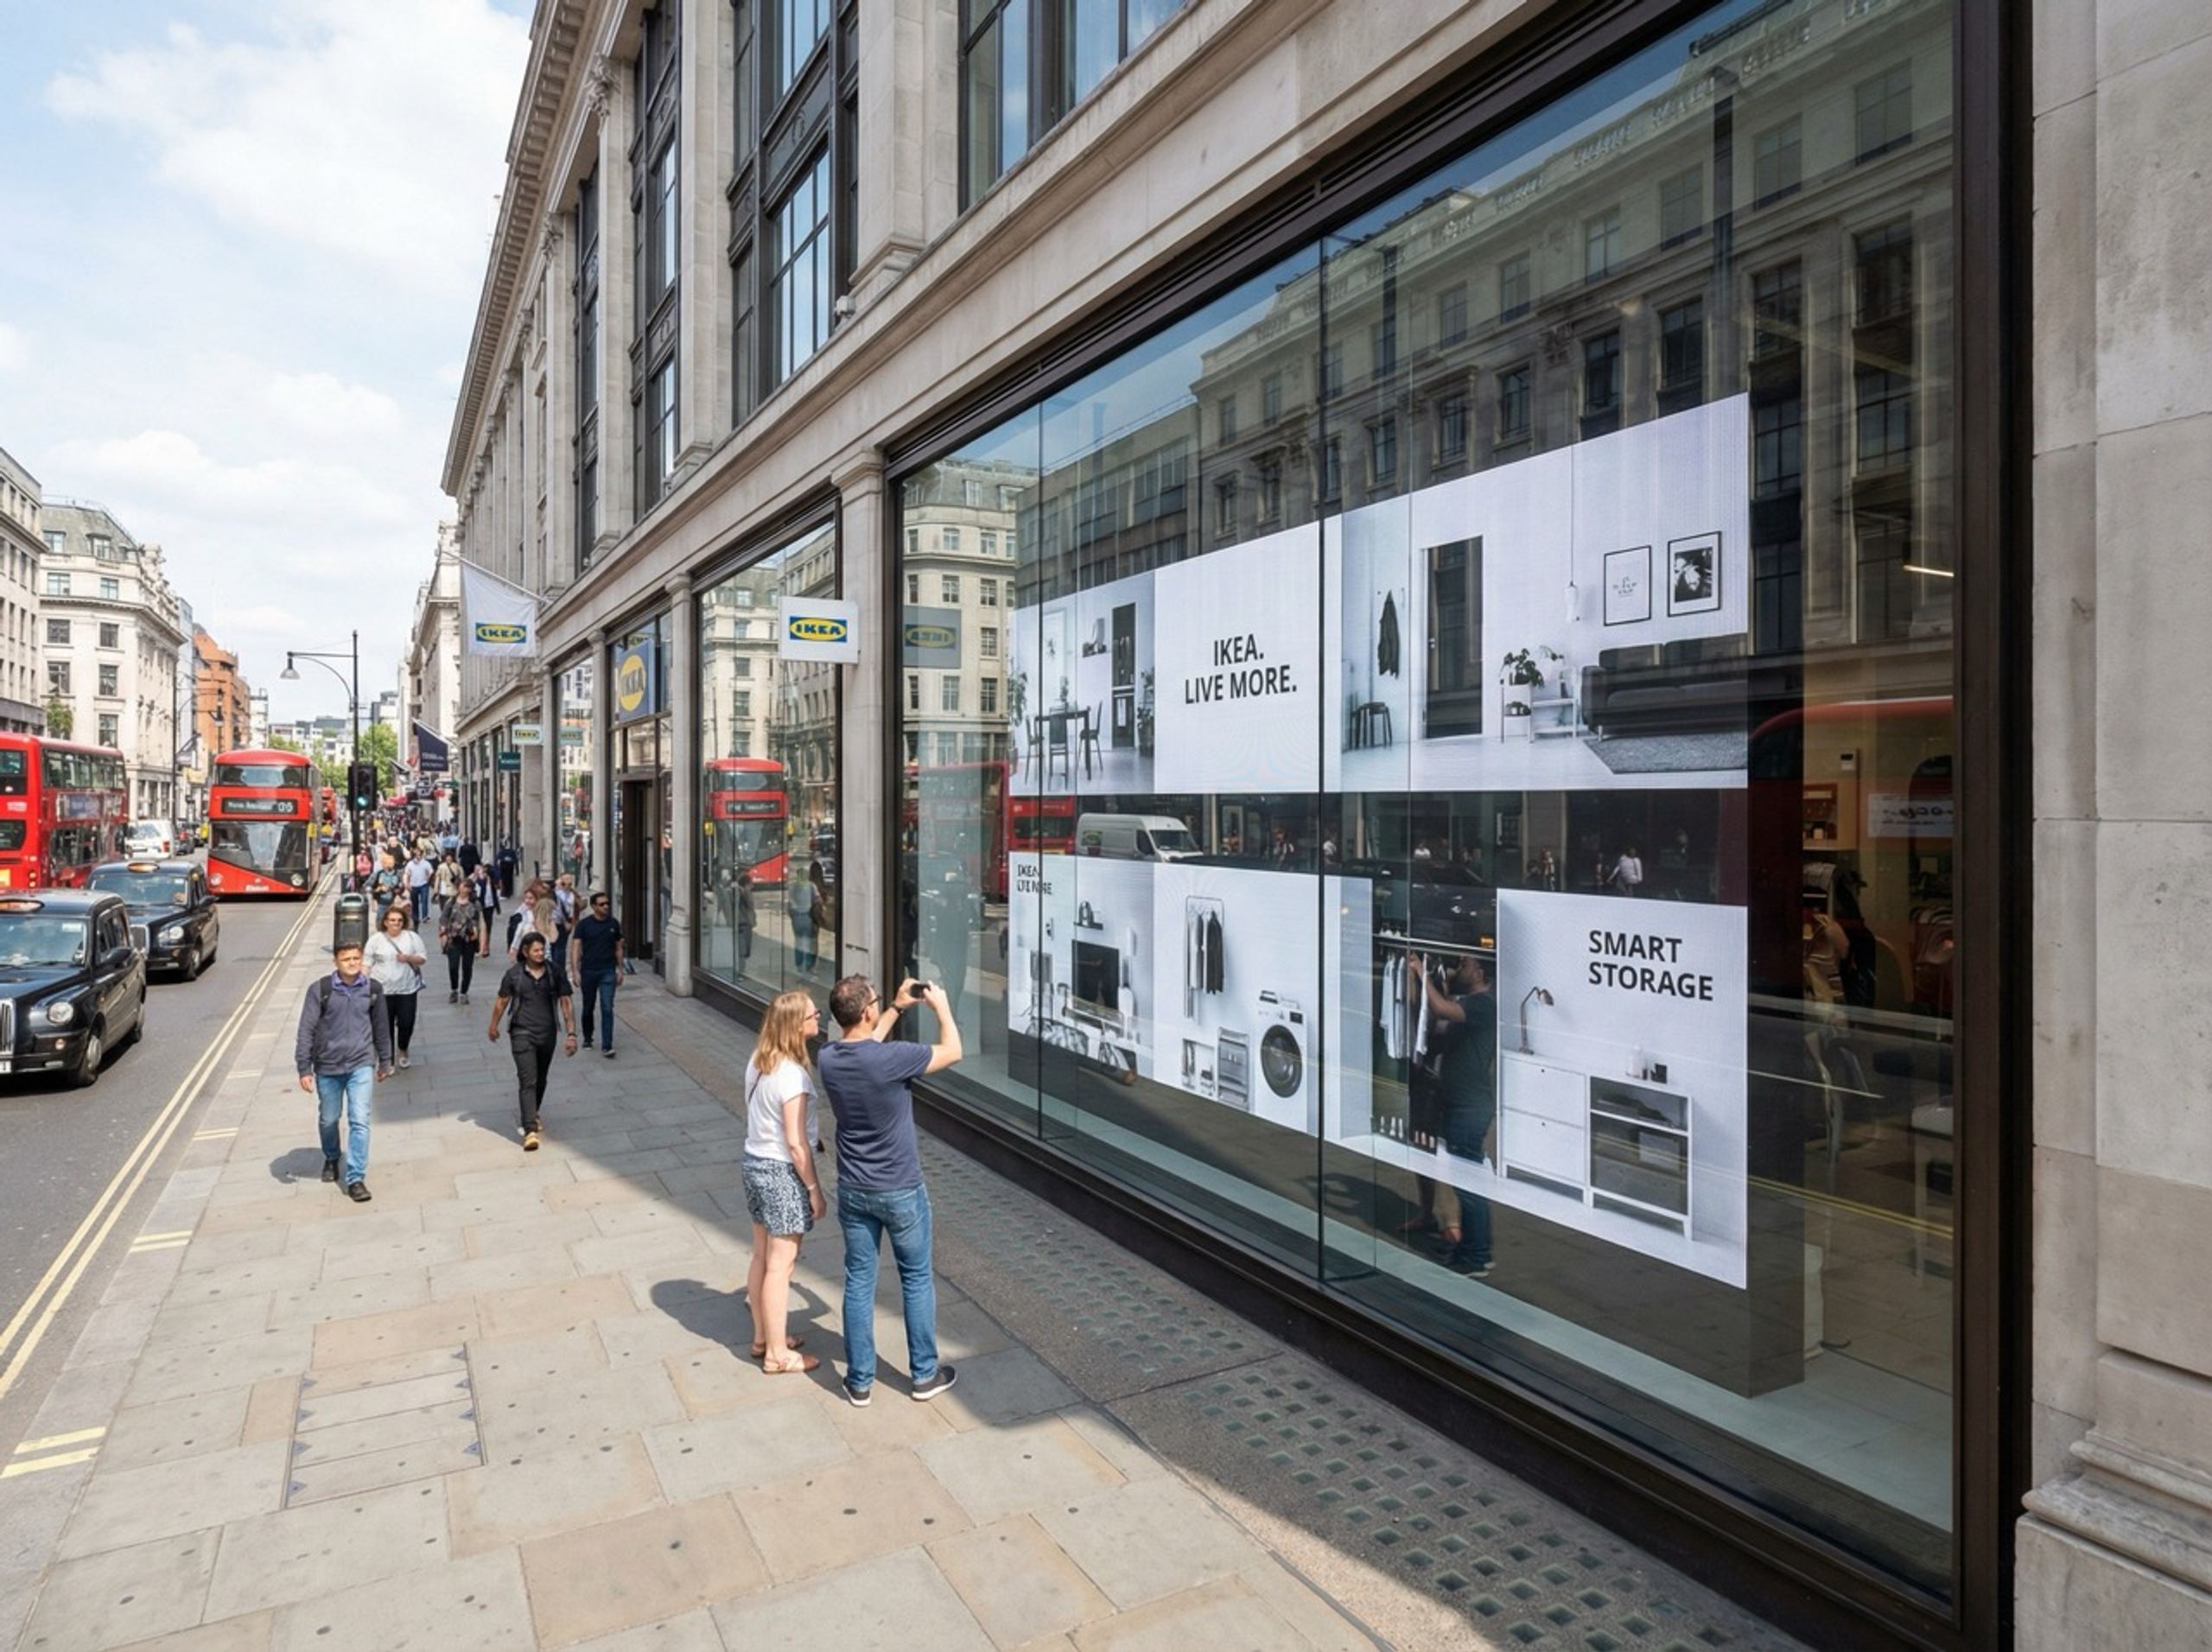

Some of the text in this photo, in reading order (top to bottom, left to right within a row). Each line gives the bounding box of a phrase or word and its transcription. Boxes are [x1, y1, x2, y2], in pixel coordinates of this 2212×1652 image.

[480, 628, 522, 637] IKEA
[796, 624, 842, 636] IKEA
[1213, 633, 1264, 666] IKEA.
[1185, 664, 1297, 704] LIVE MORE.
[1588, 930, 1682, 963] SMART
[1588, 962, 1713, 1002] STORAGE
